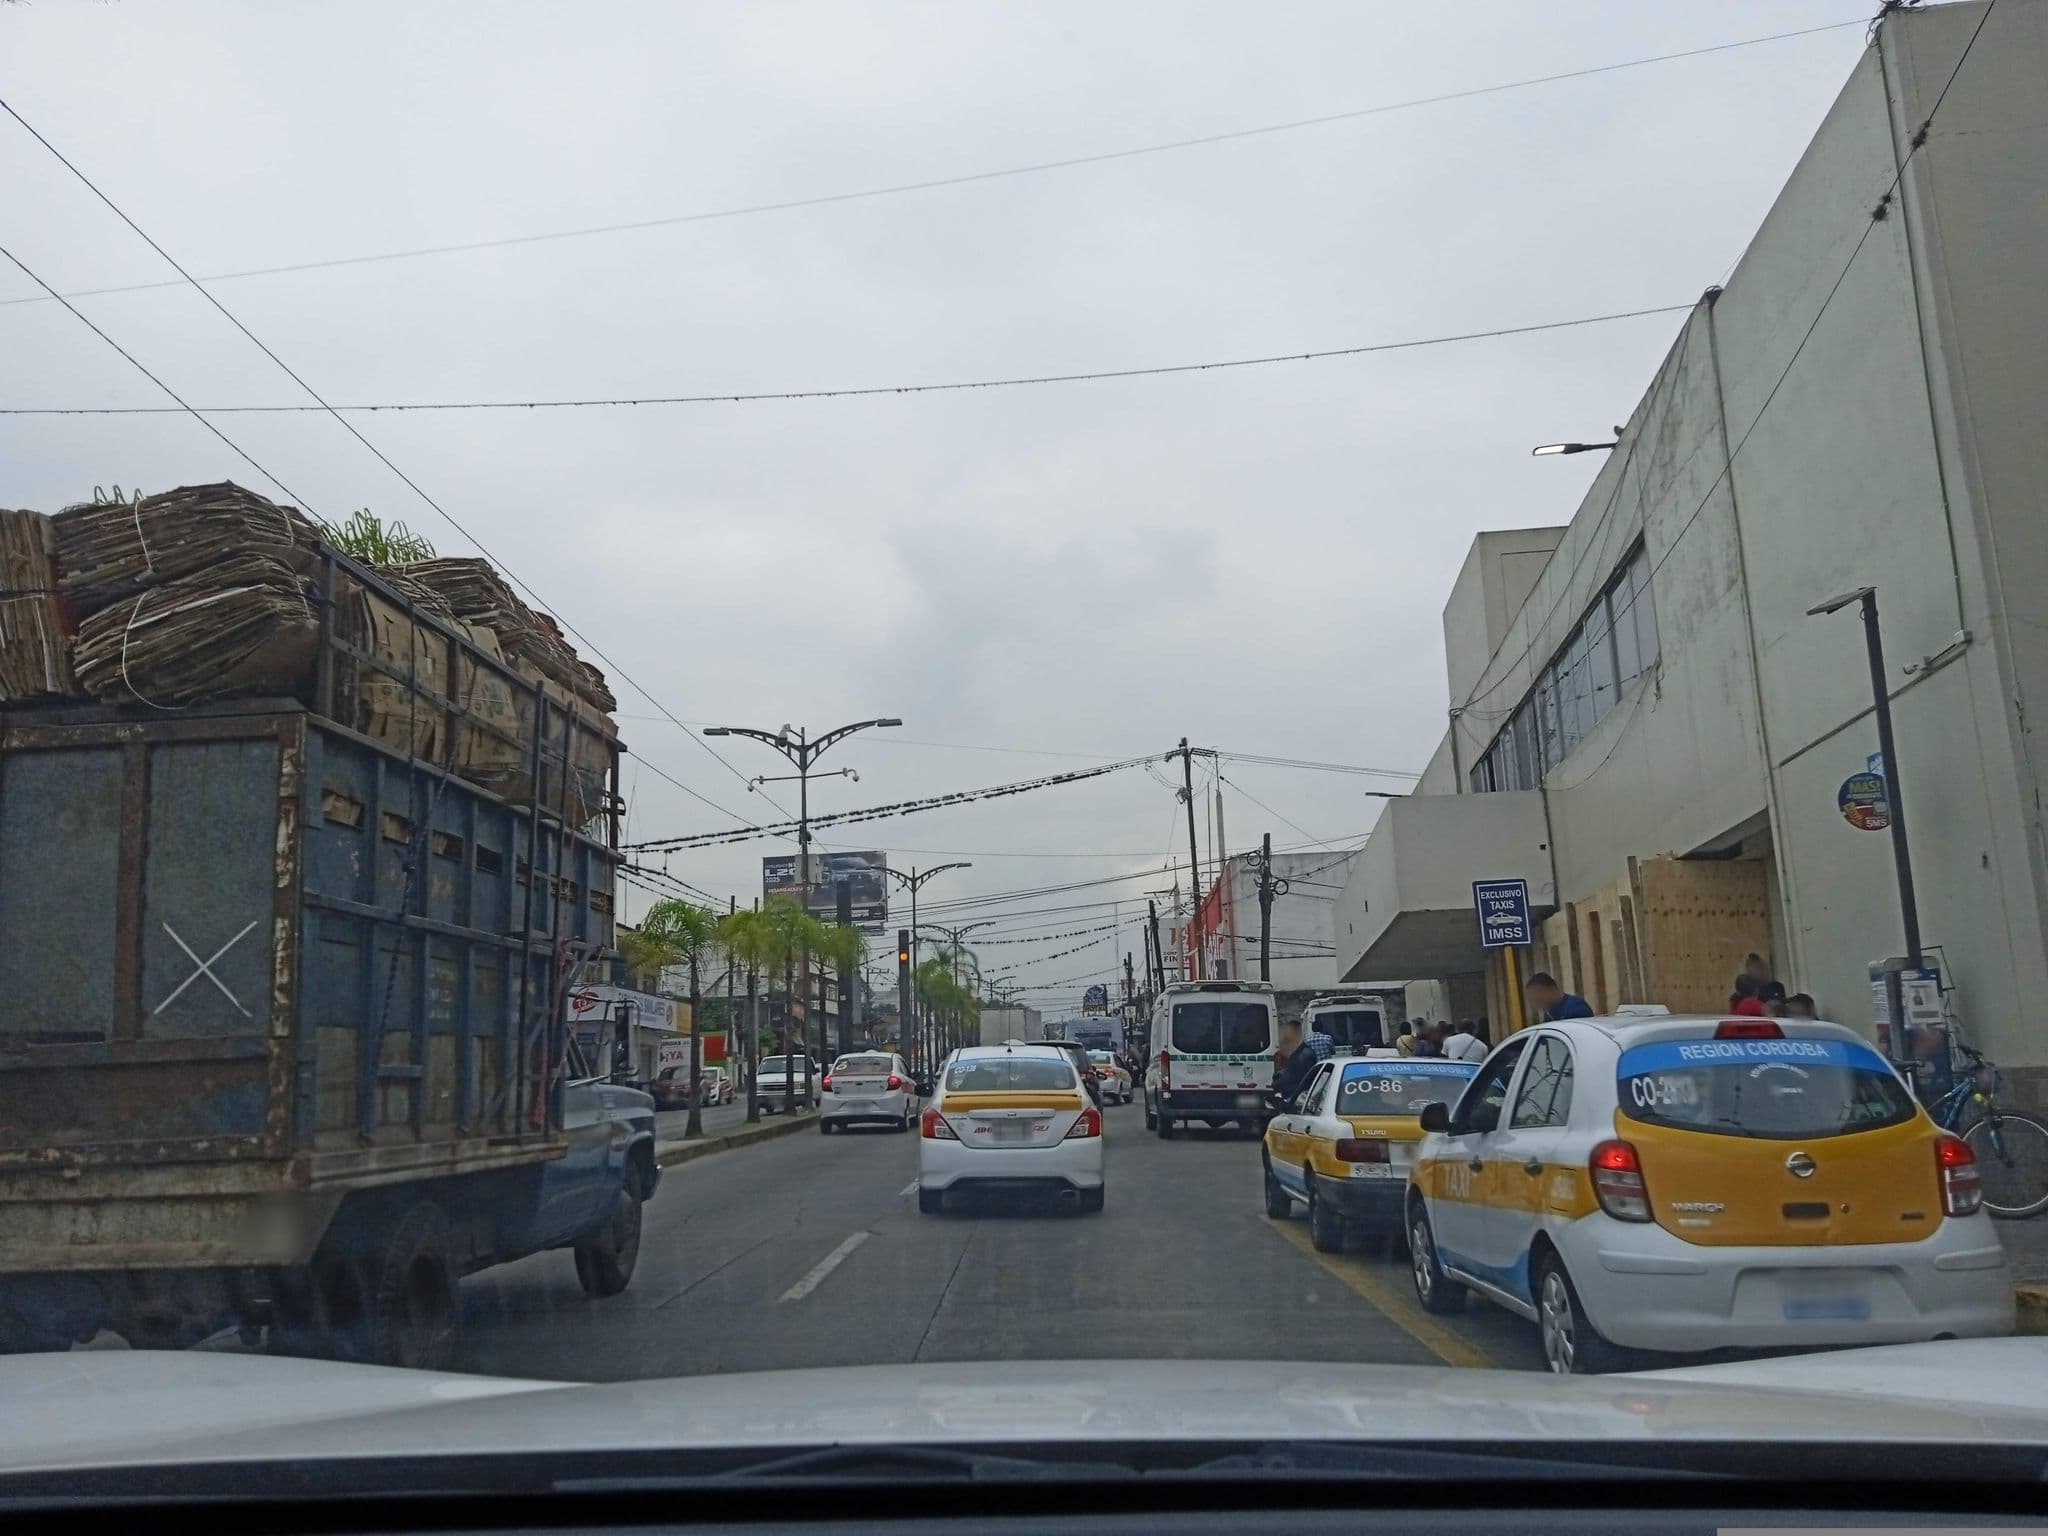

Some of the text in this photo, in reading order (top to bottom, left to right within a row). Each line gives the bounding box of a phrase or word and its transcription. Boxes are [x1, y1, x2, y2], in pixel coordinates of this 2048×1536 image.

[1480, 889, 1522, 900] EXCLUSIVO
[1489, 900, 1515, 910] TAXIS
[1489, 927, 1523, 940] IMSS
[1679, 1042, 1829, 1060] REGION CORDOBA
[1369, 1064, 1469, 1075] REGION CORDOBA
[1344, 1080, 1402, 1095] CO-86
[1671, 1202, 1724, 1213] MARCH
